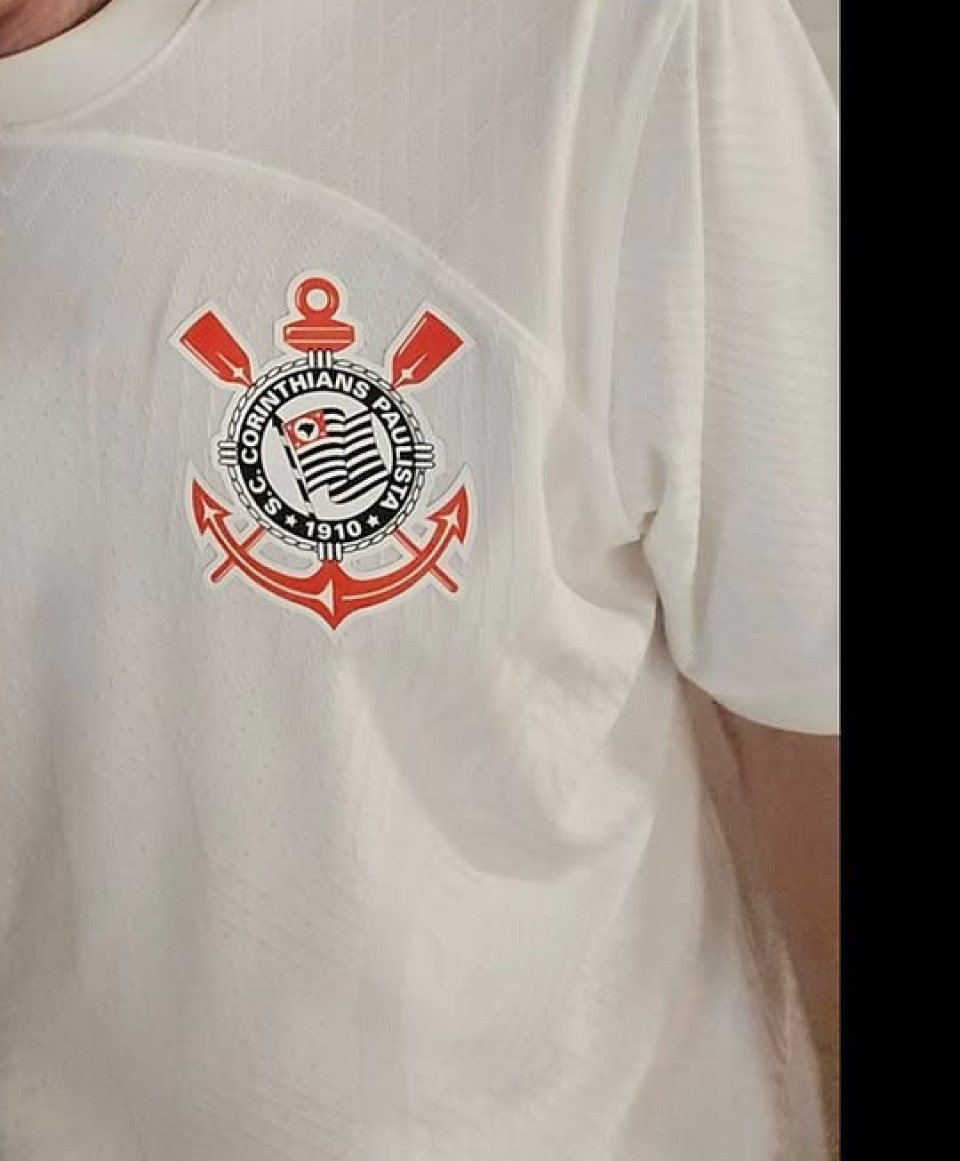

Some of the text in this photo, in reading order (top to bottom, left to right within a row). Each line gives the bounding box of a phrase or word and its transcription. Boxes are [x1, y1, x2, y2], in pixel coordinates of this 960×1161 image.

[242, 371, 371, 465] CORINTHIANS
[372, 397, 413, 511] PAULISTA
[305, 520, 362, 540] 1910
